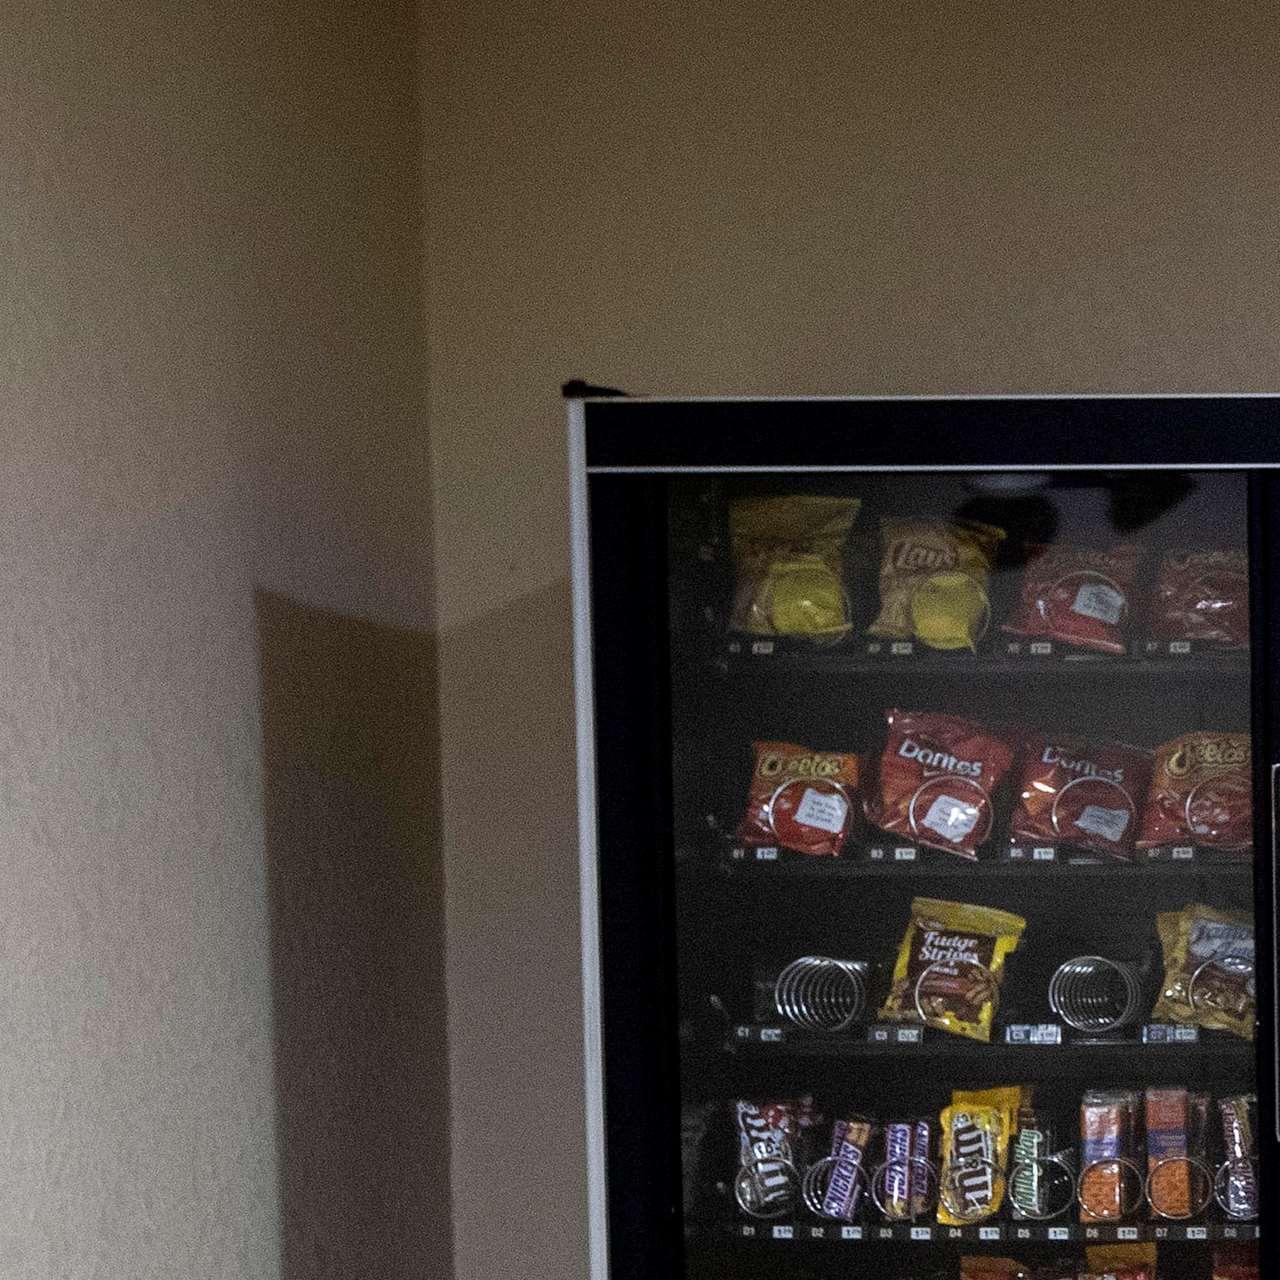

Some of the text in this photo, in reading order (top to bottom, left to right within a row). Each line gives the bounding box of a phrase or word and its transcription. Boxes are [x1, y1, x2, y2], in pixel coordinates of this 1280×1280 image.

[899, 738, 983, 777] Doritos
[923, 931, 978, 951] Fudge
[918, 947, 979, 964] Stripes
[823, 1141, 863, 1219] SNICKERS
[811, 1227, 824, 1237] D2
[949, 1228, 962, 1238] D4
